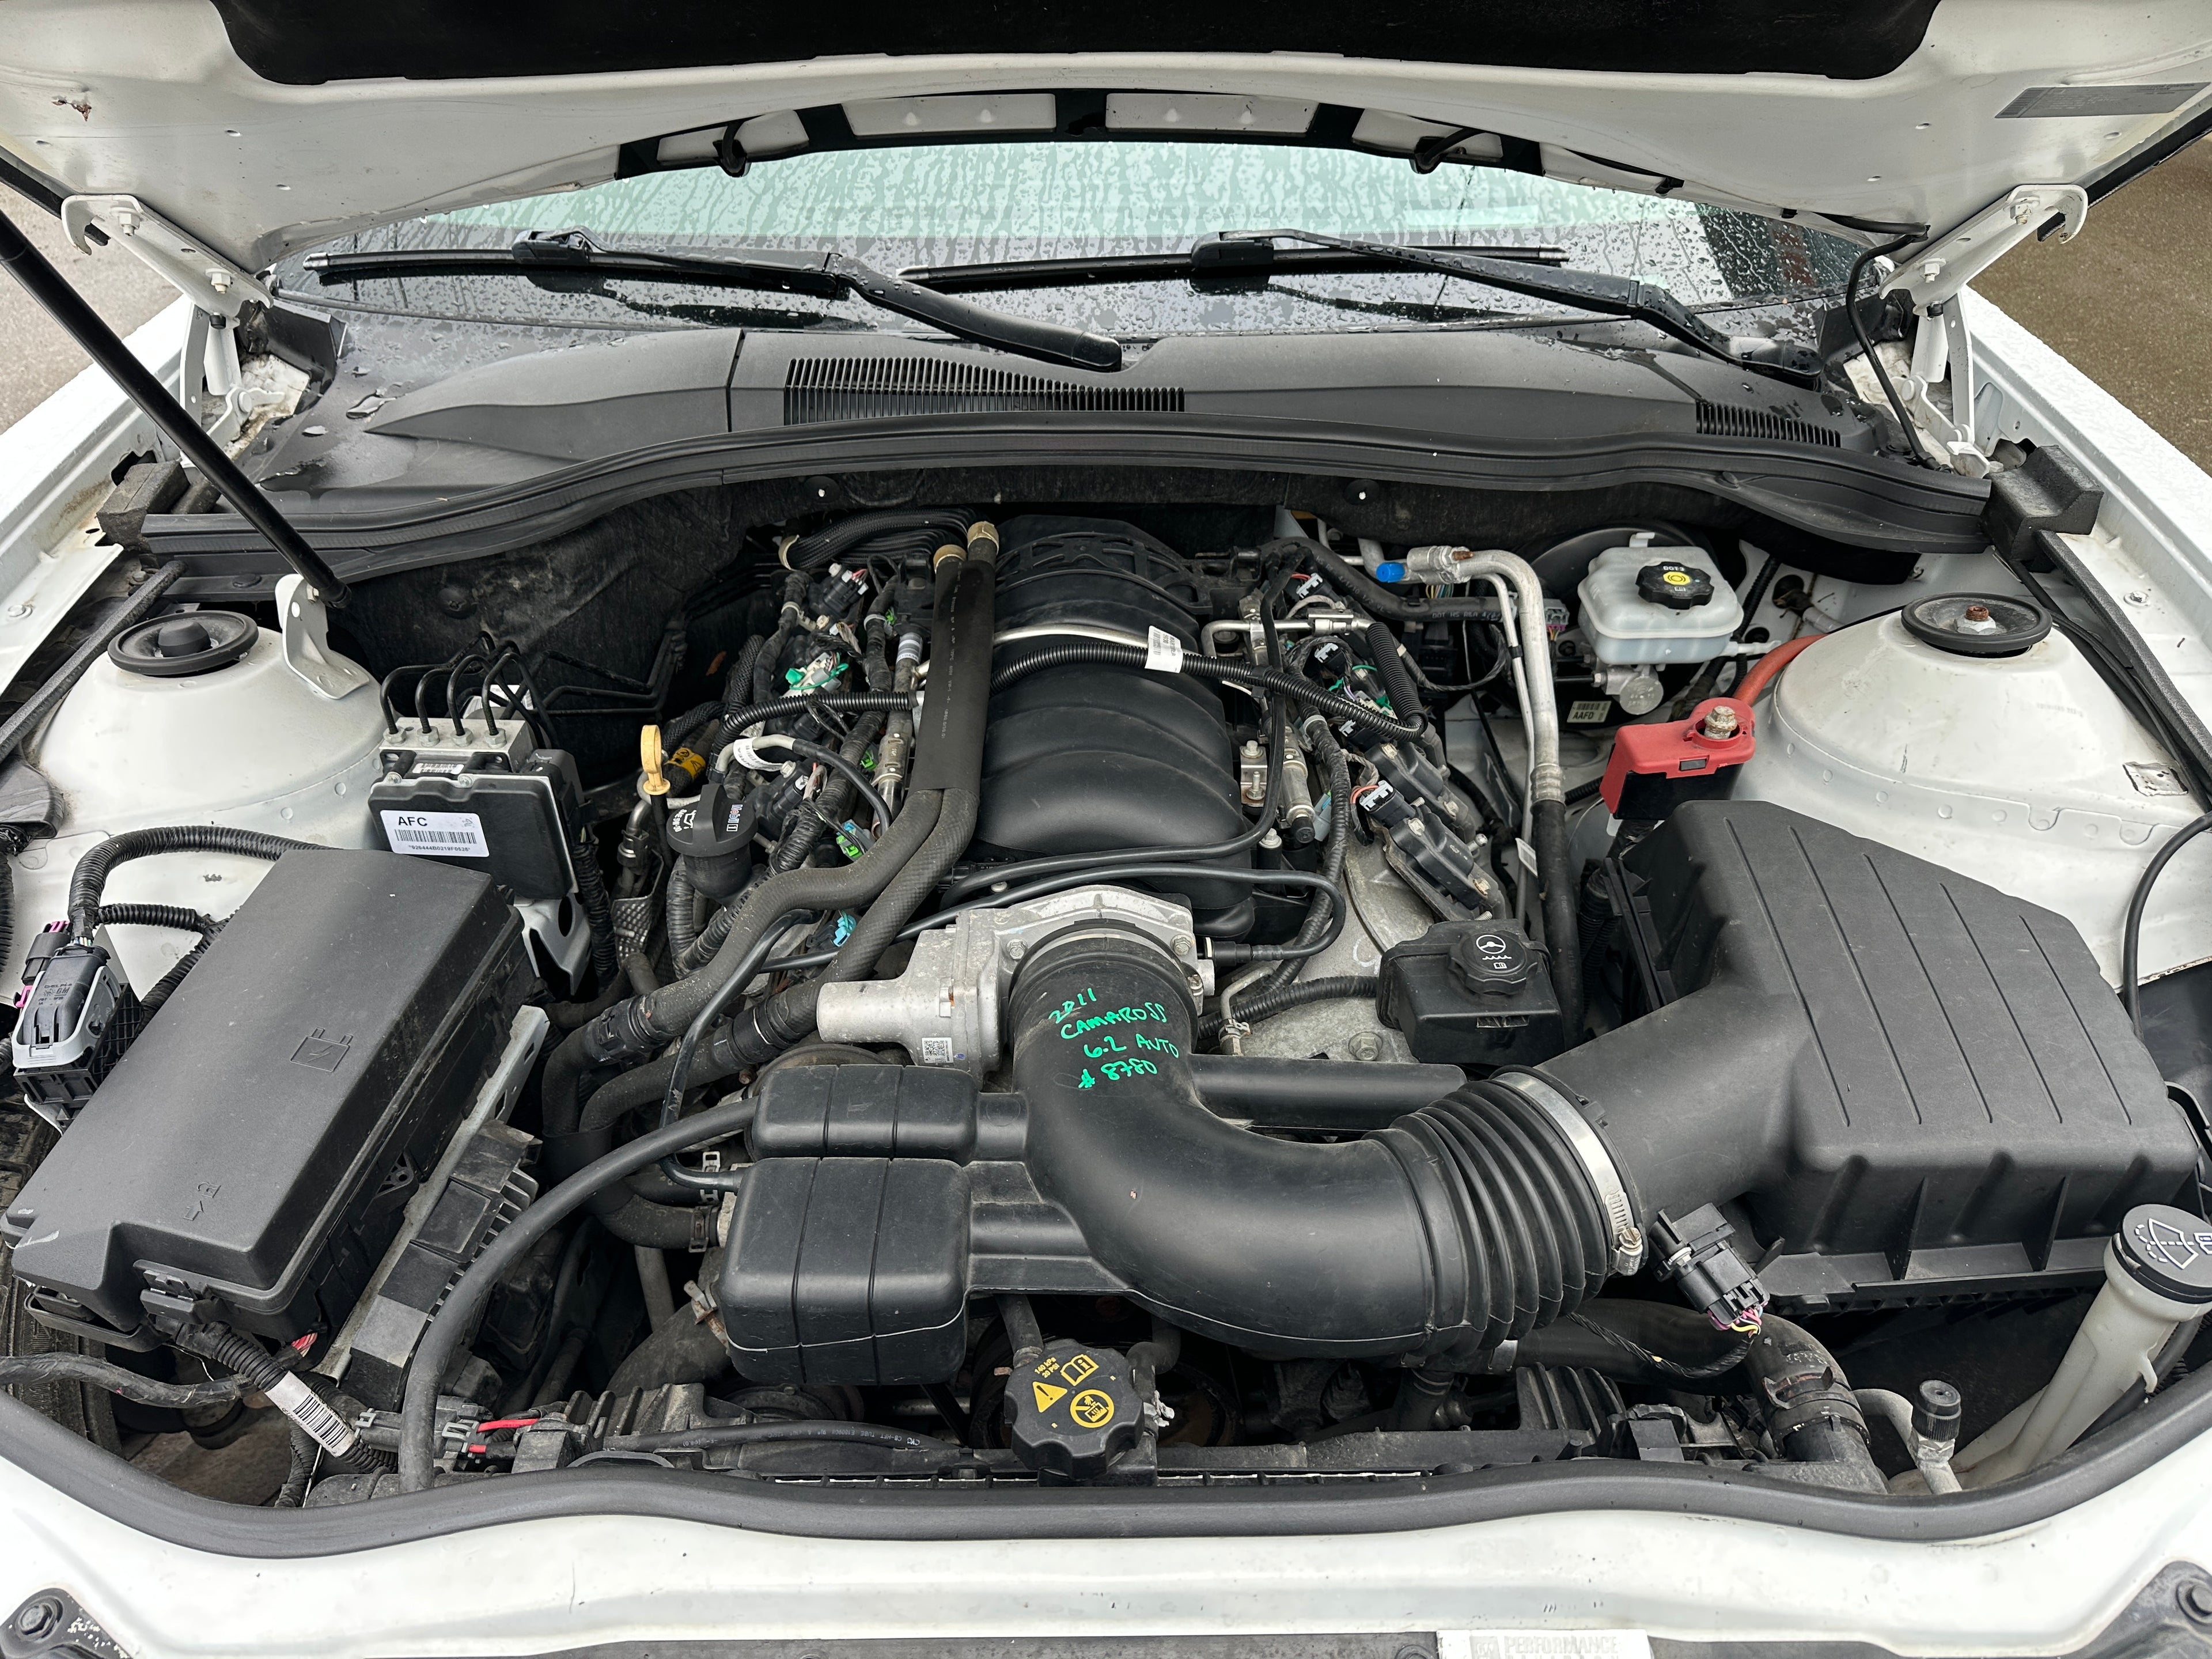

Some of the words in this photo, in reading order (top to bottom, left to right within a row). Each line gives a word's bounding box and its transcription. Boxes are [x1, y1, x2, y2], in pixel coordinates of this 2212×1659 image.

[1572, 711, 1594, 719] AAFD
[398, 816, 428, 827] AFC
[728, 804, 744, 824] Mobil
[1048, 987, 1097, 1024] 2011
[1083, 1035, 1127, 1058] 6.2
[1135, 1033, 1180, 1059] AUTO
[1100, 1057, 1158, 1081] 8780
[1035, 1363, 1044, 1374] 140
[1043, 1357, 1057, 1368] kPa
[1041, 1369, 1051, 1378] 20
[1050, 1362, 1060, 1373] PSI
[860, 1430, 875, 1438] TUBE
[1503, 1635, 1618, 1654] PERFORMANCE
